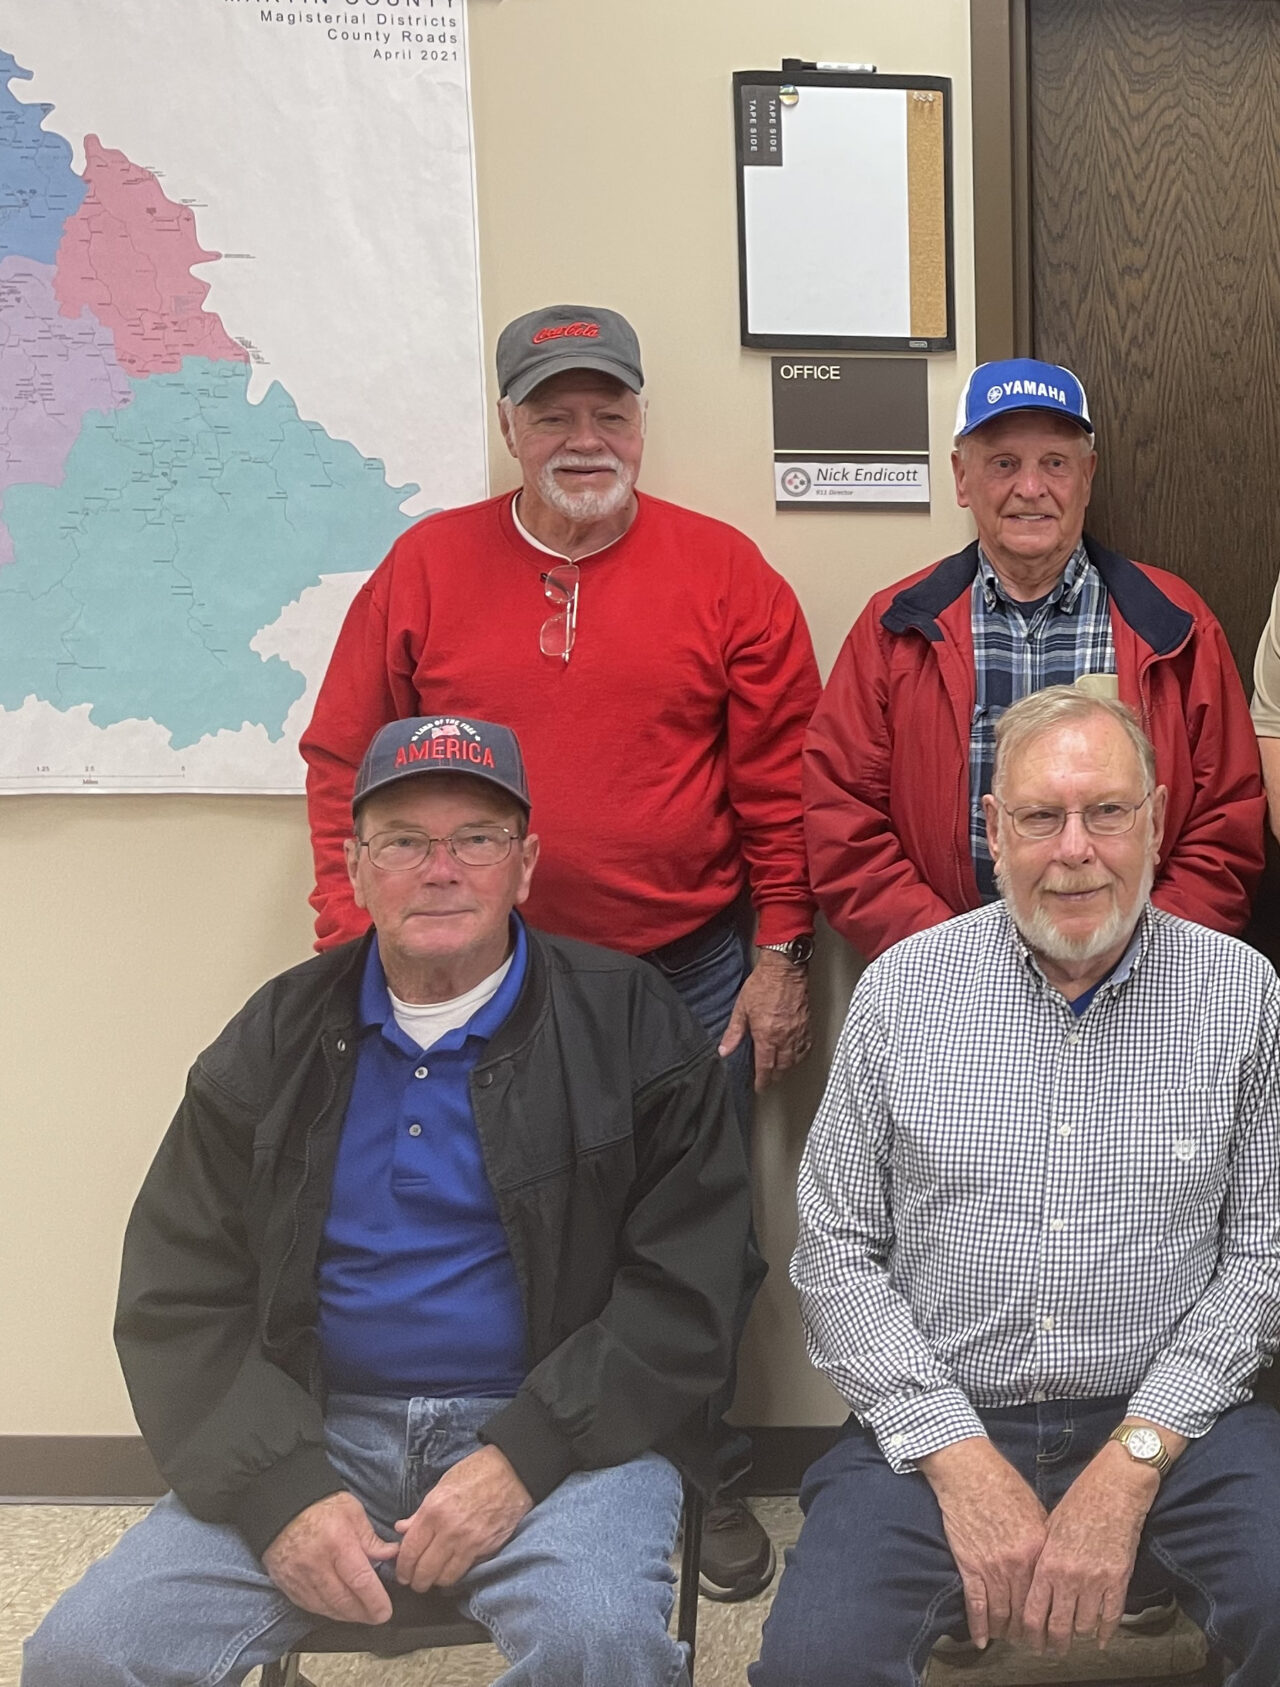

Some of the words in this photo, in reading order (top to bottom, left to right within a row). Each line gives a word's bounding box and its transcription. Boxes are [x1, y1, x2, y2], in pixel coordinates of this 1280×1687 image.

[260, 10, 366, 25] Magisterial
[377, 13, 457, 27] Districts
[327, 28, 391, 44] County
[402, 31, 458, 44] Roads
[373, 49, 412, 61] April
[421, 50, 458, 61] 2021
[749, 99, 757, 124] TAPE
[769, 99, 777, 124] TAPE
[750, 128, 758, 152] SIDE
[769, 128, 778, 152] SIDE
[780, 364, 841, 380] OFFICE
[1002, 379, 1067, 406] YAMAHA
[816, 467, 850, 482] Nick
[854, 467, 919, 482] Endicott
[445, 718, 460, 726] THE
[394, 738, 496, 769] AMERICA
